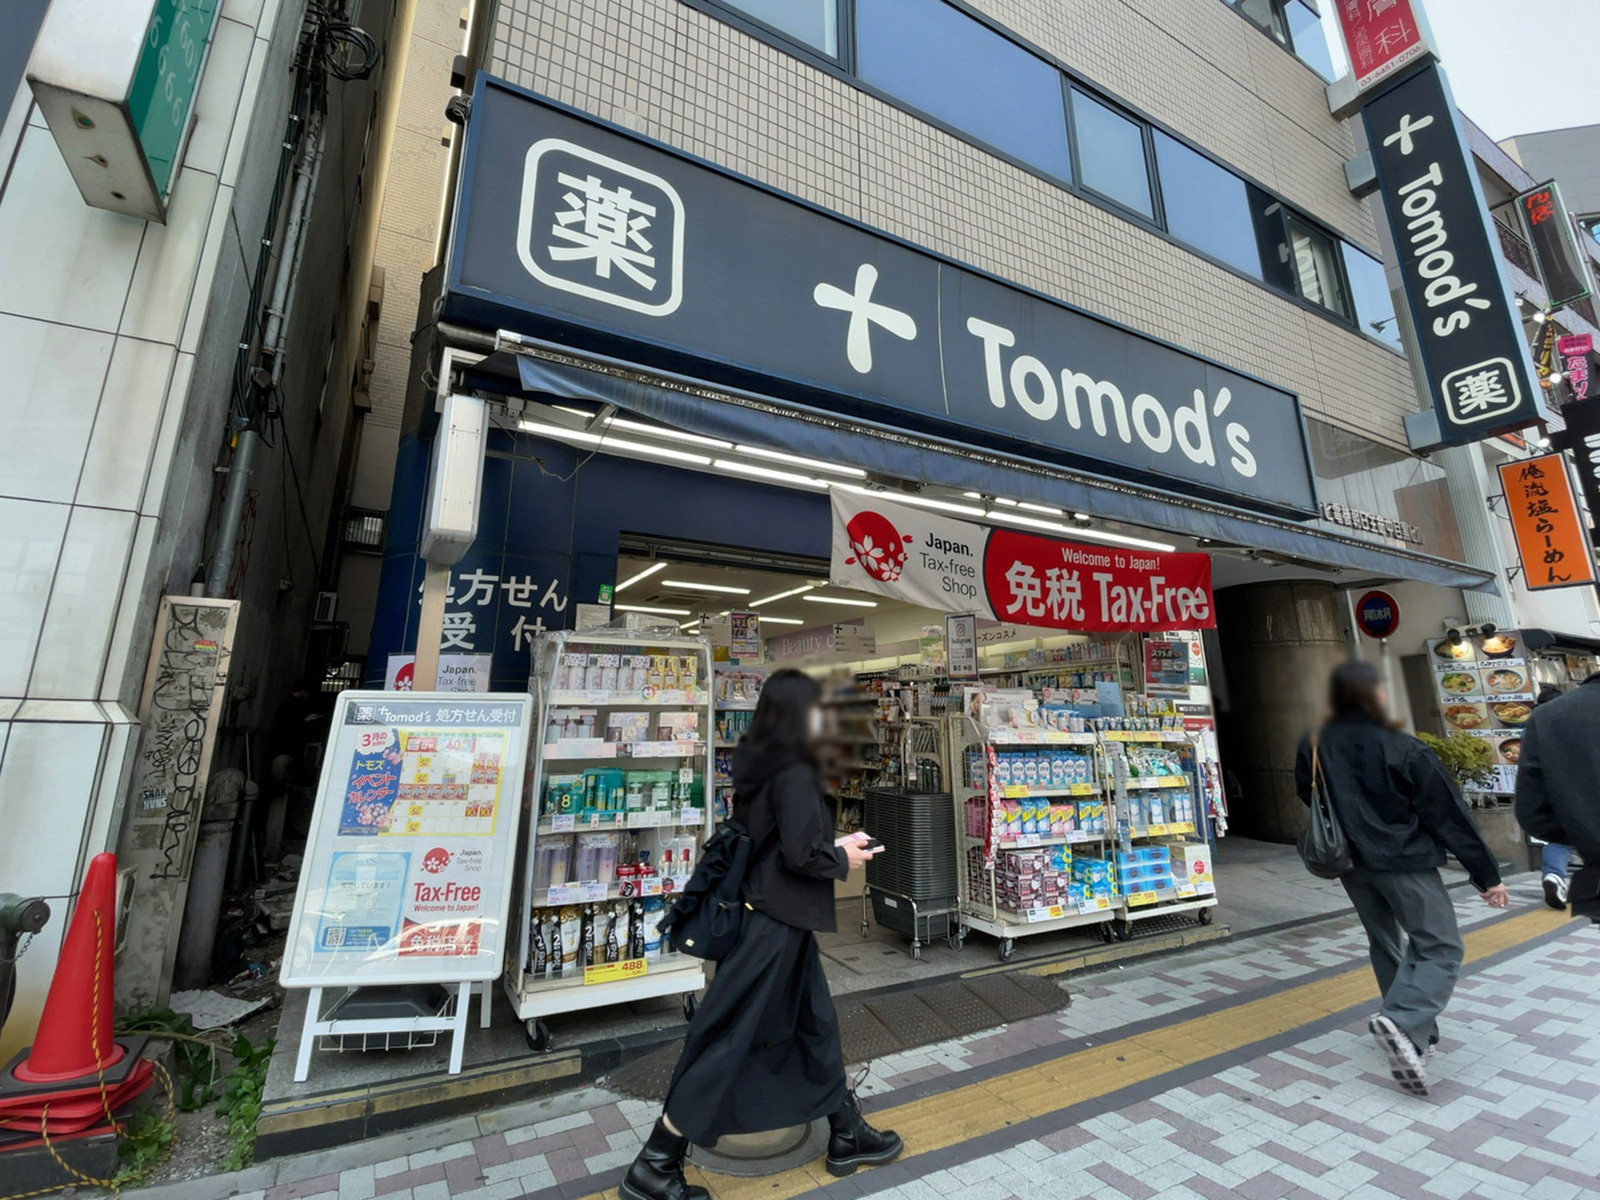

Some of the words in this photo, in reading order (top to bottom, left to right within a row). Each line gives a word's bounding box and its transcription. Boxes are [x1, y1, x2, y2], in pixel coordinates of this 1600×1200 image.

[1360, 45, 1422, 87] 03-6451-0706
[548, 171, 657, 292] 薬
[1397, 161, 1491, 337] Tomod's
[1567, 355, 1589, 401] たまり
[966, 316, 1258, 478] Tomod's
[1454, 369, 1508, 415] 薬
[1518, 462, 1571, 582] 俺流塩らーめん
[925, 532, 974, 557] Japan.
[919, 551, 976, 579] Tax-free
[1061, 547, 1111, 568] Welcome
[1114, 555, 1126, 569] to
[1129, 554, 1161, 573] Japan!
[942, 575, 977, 600] Shop
[1004, 559, 1086, 622] 免税
[1092, 571, 1210, 623] Tax-Free
[438, 676, 476, 687] Tax-free
[443, 664, 478, 676] Japan.
[357, 706, 373, 721] 薬
[384, 710, 431, 723] Tomod's
[435, 708, 518, 723] 処方せん受付
[355, 759, 385, 770] トモズ
[352, 772, 397, 789] イベント
[349, 787, 395, 804] カレンダー
[414, 882, 481, 902] Tax-Free
[414, 904, 446, 912] Welcome
[447, 904, 455, 912] to
[456, 903, 479, 913] Japan!
[622, 960, 643, 971] 488
